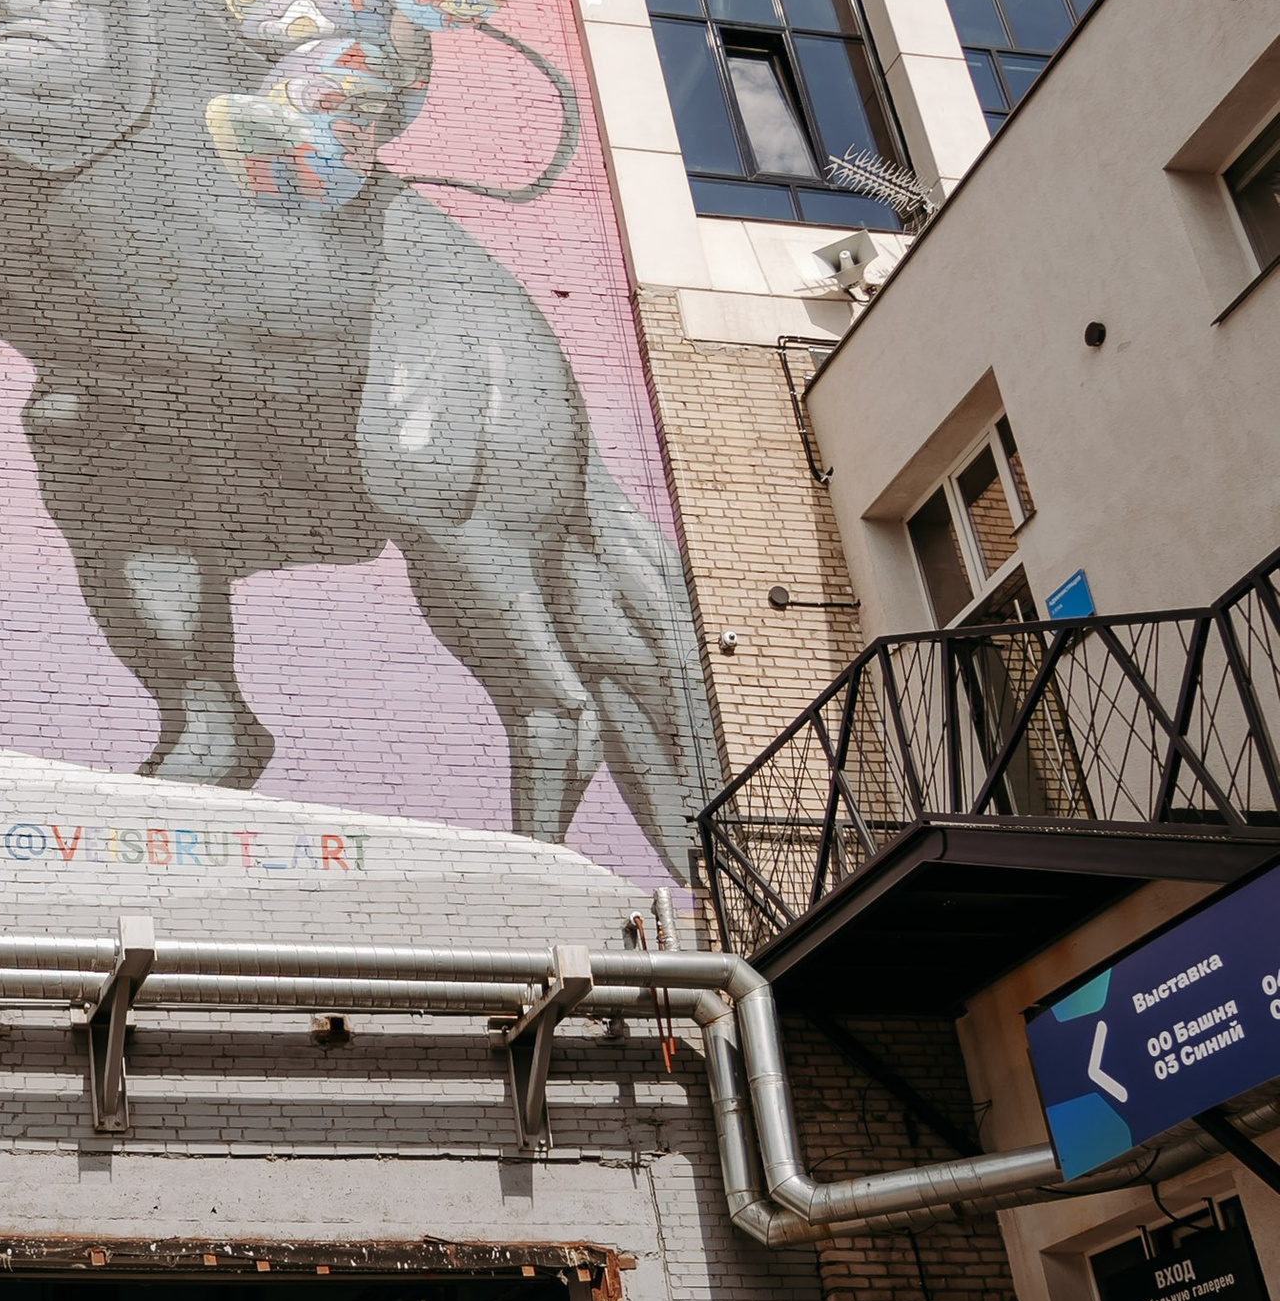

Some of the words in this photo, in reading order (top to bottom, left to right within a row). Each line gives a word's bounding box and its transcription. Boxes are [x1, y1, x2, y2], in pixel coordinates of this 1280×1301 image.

[4, 823, 371, 871] @VEISBRUT_ART
[1132, 954, 1223, 1014] Выставка
[1262, 968, 1280, 996] 0
[1147, 1030, 1173, 1057] 00
[1173, 1000, 1238, 1043] Башня
[1154, 1053, 1179, 1080] 03
[1180, 1020, 1245, 1066] Синий
[1154, 1259, 1196, 1289] ВХОД
[1192, 1273, 1235, 1297] галерею
